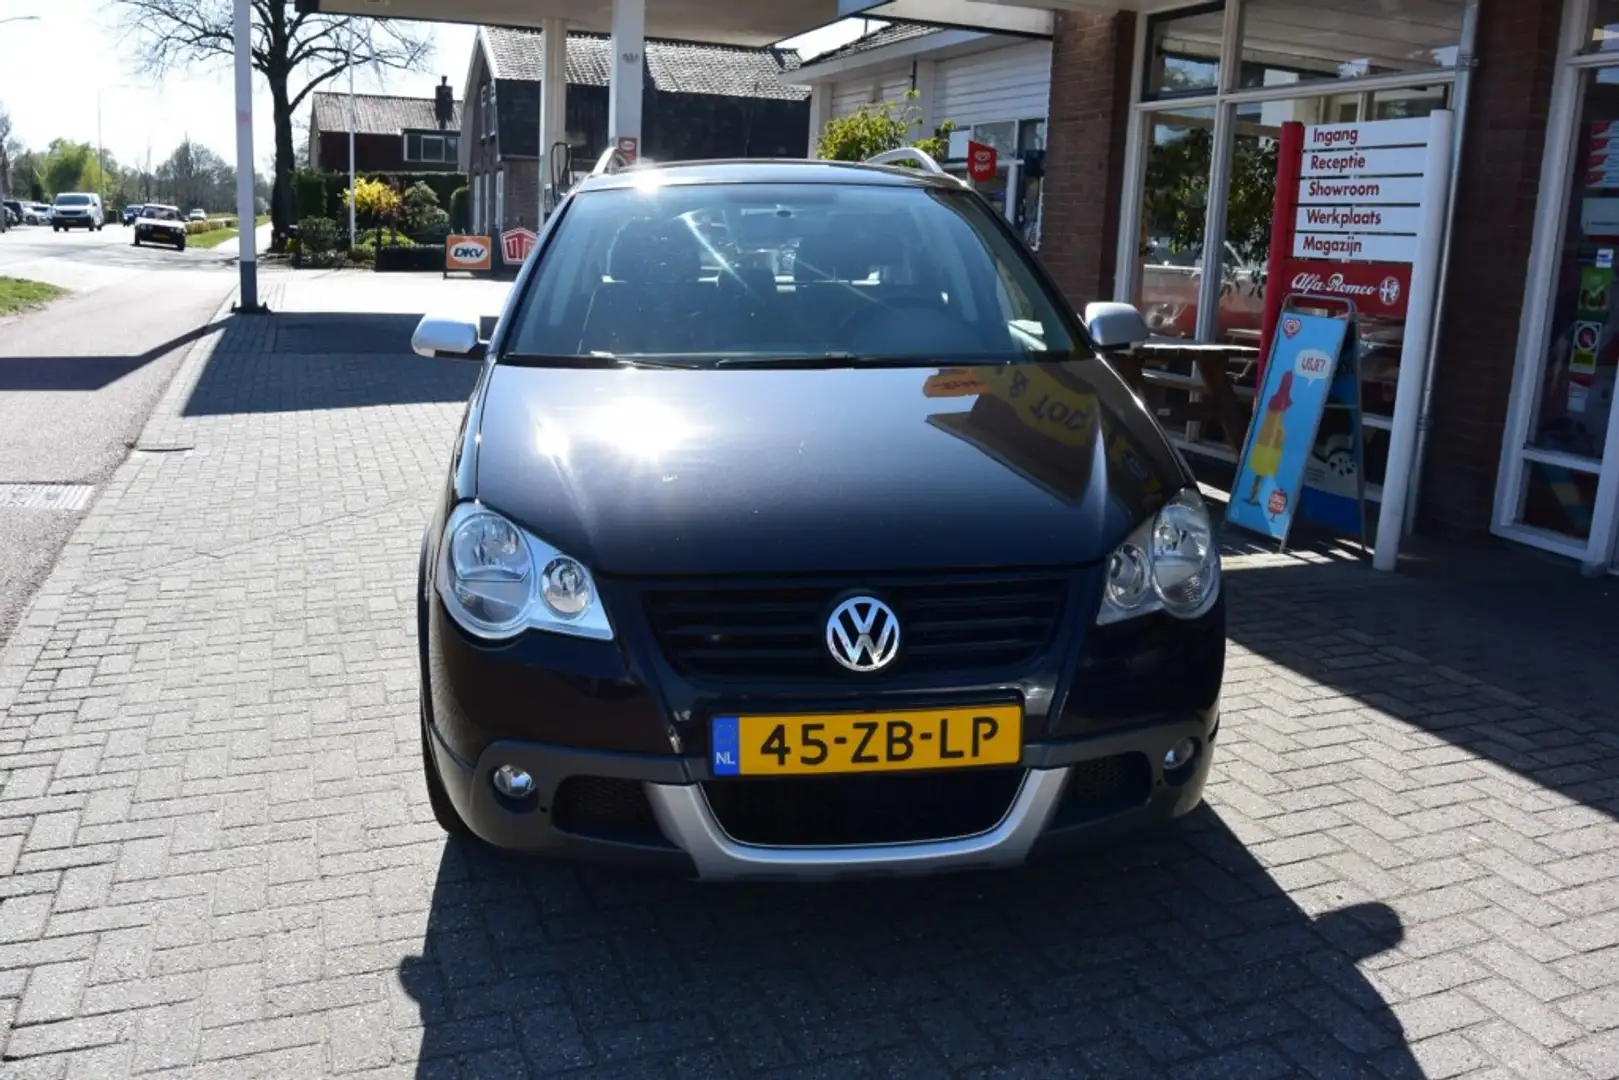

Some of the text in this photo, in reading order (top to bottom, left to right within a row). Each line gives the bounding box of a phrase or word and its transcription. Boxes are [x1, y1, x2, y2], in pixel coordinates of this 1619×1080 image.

[1313, 128, 1358, 146] Ingang
[1311, 154, 1365, 173] Receptie
[1308, 181, 1380, 197] Showroom
[1306, 209, 1381, 228] Werkplaats
[454, 247, 484, 258] DKV
[1303, 236, 1362, 256] Magazijn
[1291, 272, 1377, 295] Alfa Romeo
[760, 716, 999, 766] 45-ZB-LP
[715, 752, 735, 765] NL
